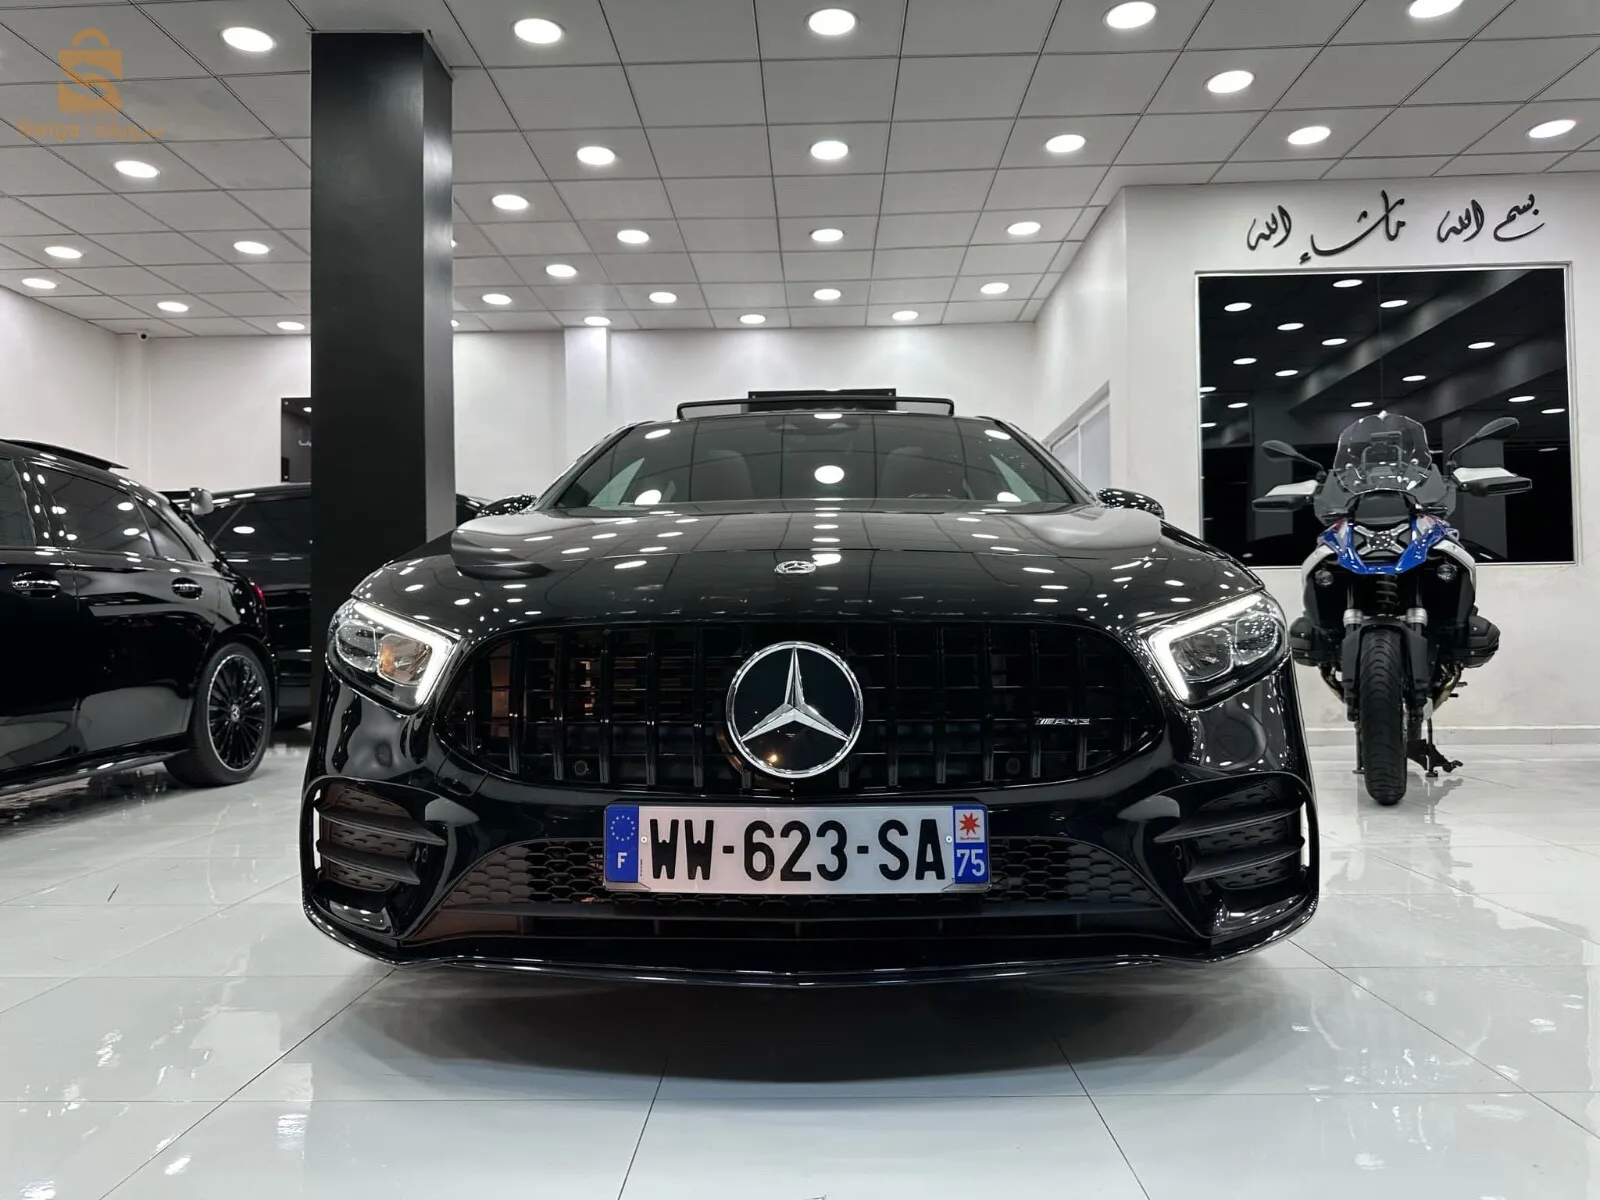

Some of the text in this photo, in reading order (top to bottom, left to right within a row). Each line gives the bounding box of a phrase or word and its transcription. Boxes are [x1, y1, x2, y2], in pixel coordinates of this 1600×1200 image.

[1247, 205, 1292, 251] الله
[1437, 199, 1485, 243] الله
[1494, 193, 1546, 242] بسم
[617, 852, 628, 869] F
[649, 818, 946, 882] WW-623-SA
[956, 849, 985, 877] 75
